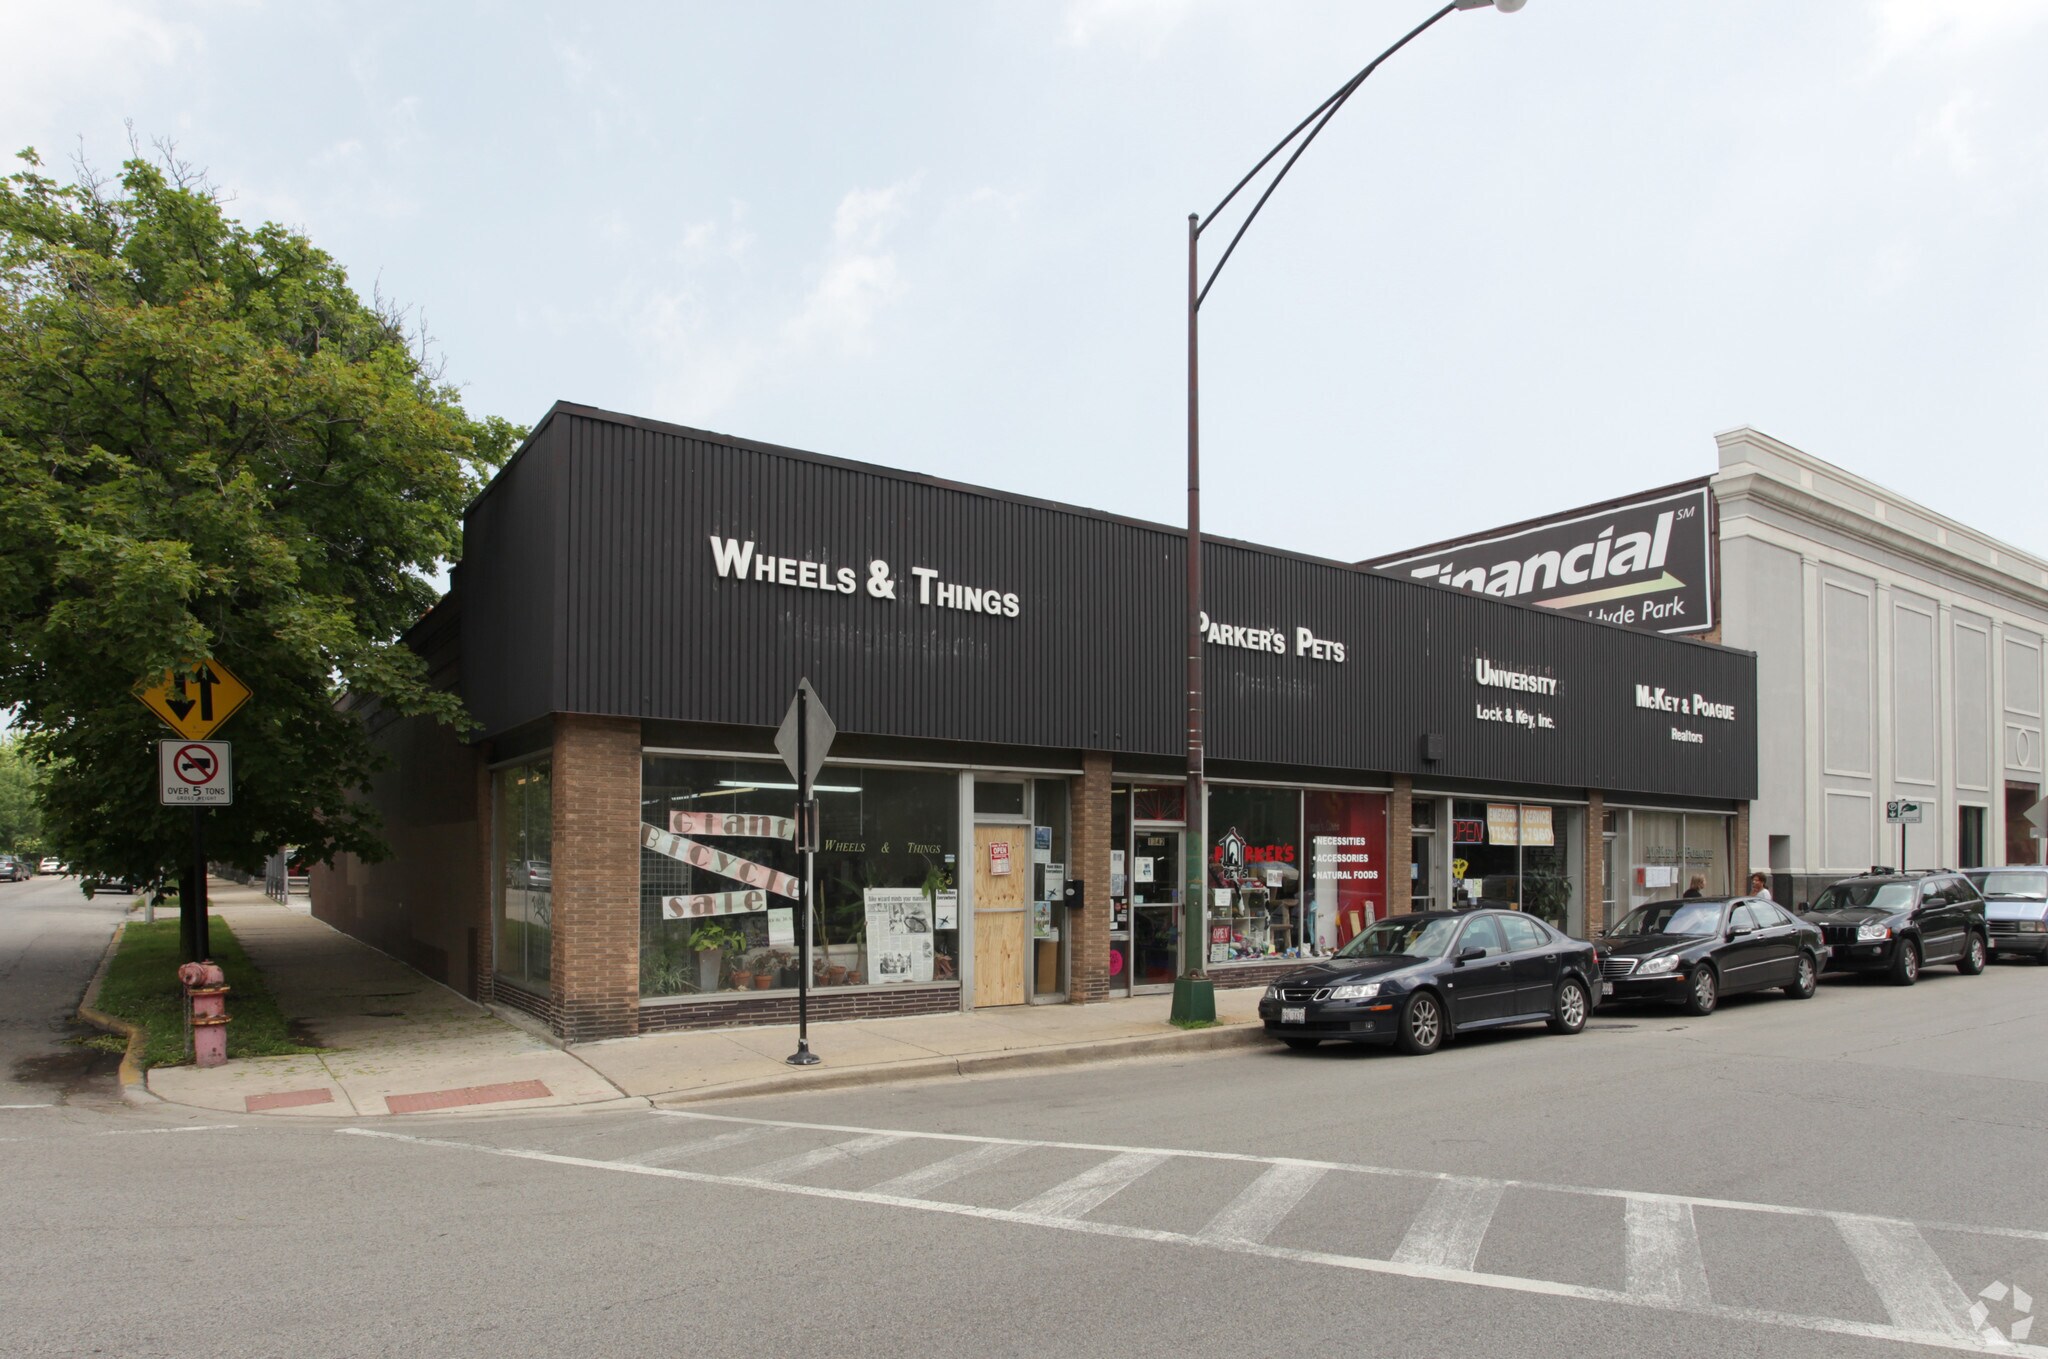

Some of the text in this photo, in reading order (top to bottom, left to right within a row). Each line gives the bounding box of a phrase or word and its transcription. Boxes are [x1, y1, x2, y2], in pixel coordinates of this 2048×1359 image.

[1411, 506, 1695, 597] nancial SM
[710, 536, 1020, 618] WHEELS & THINGS
[1642, 596, 1685, 621] Park
[1297, 627, 1345, 663] PETS
[1476, 658, 1557, 696] UNIVERSITY
[1476, 704, 1555, 729] Lock & Key, Inc.
[1682, 698, 1690, 714] &
[1693, 693, 1735, 721] POAGUE
[1671, 727, 1704, 744] Realtors
[167, 786, 225, 796] OVER 5 TONS
[673, 812, 788, 838] Giant
[1489, 807, 1525, 822] EMERGEN
[1317, 836, 1366, 846] NECESSITIES
[1453, 821, 1482, 842] OPEN
[825, 840, 941, 854] WHEELS & THINGS
[993, 846, 1007, 854] OPEN
[1317, 854, 1369, 863] ACCESSORIES
[641, 824, 799, 898] Bicycle
[1317, 871, 1378, 879] NATURAL FOODS
[669, 890, 763, 918] sale
[1212, 927, 1229, 939] OPEN
